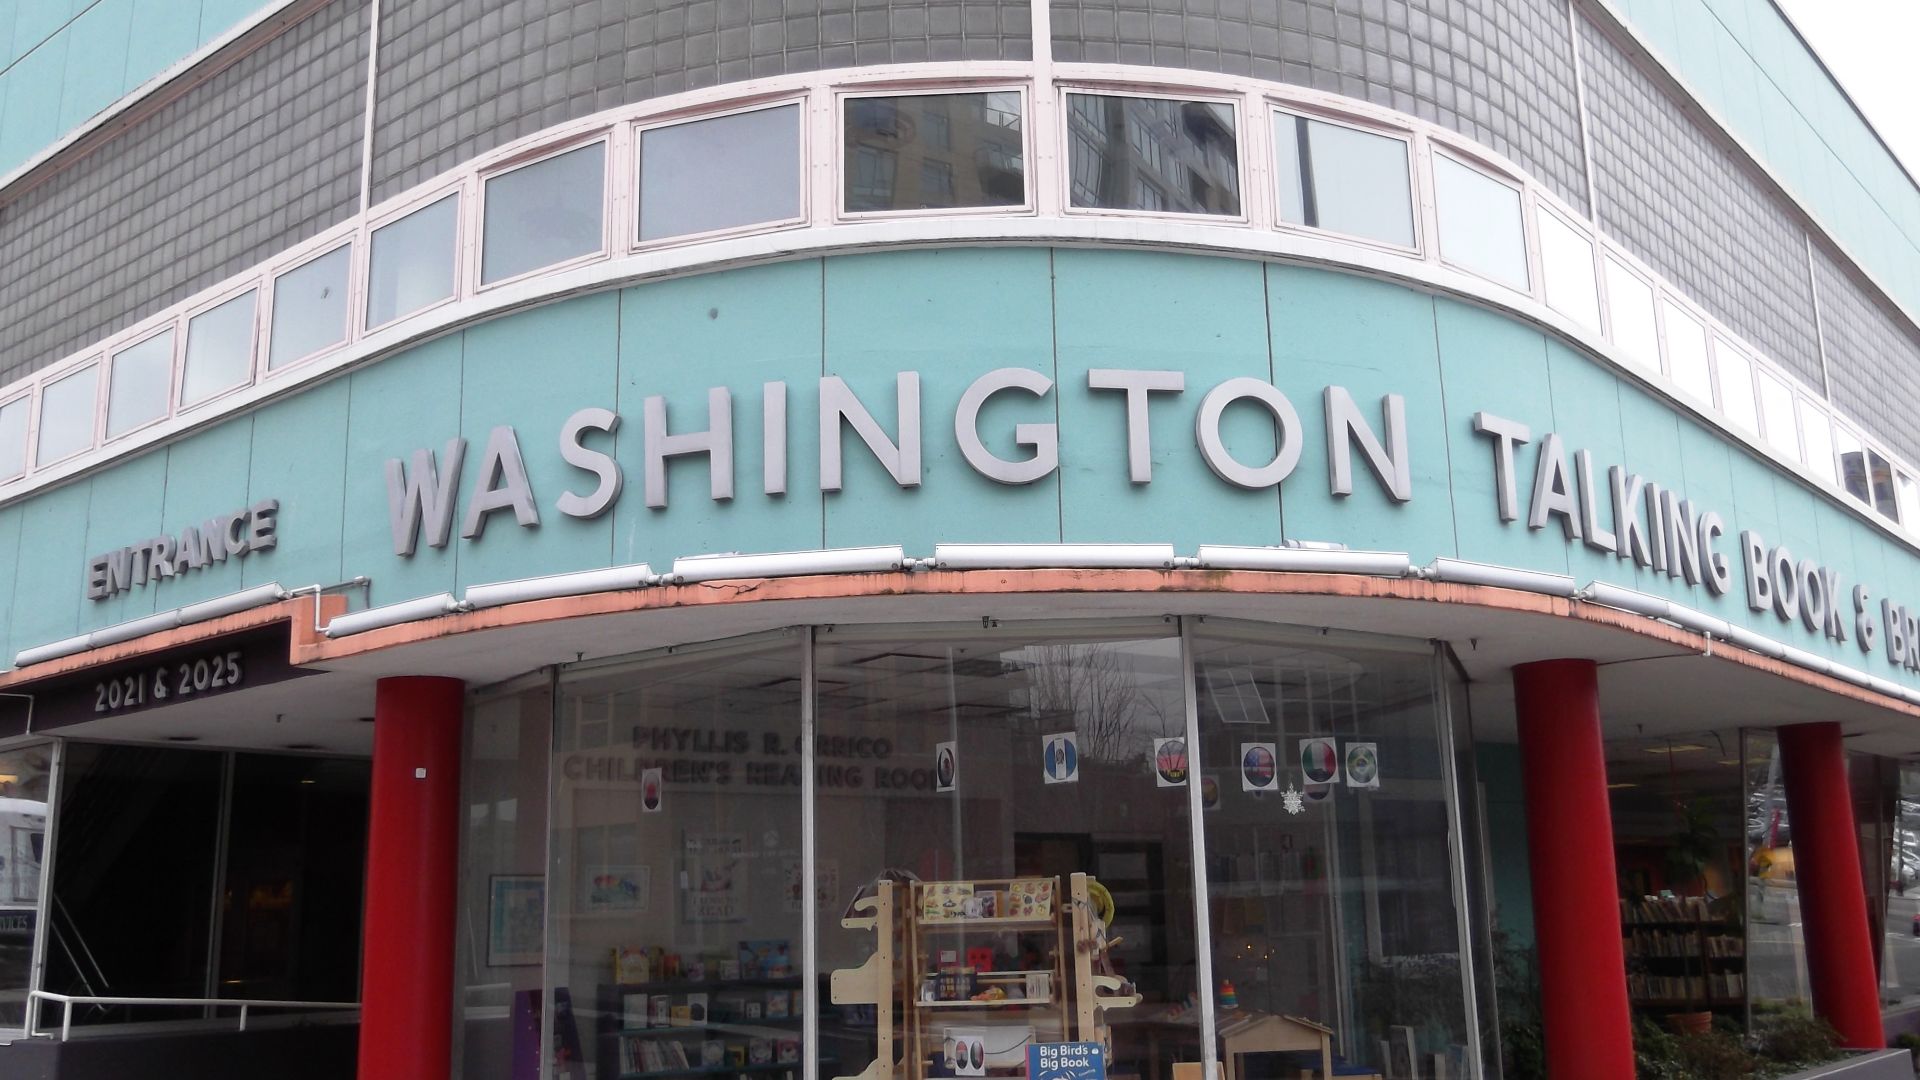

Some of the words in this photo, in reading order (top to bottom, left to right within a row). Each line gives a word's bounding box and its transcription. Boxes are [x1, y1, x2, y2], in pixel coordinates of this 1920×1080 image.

[384, 367, 1412, 557] WASHINGTON
[1473, 411, 1731, 596] TALKING
[1741, 530, 1848, 643] BOOK
[1853, 584, 1873, 654] &
[1881, 598, 1920, 675] BR
[88, 499, 279, 602] ENTRANCE
[94, 674, 145, 712] 2021
[154, 668, 170, 698] &
[179, 652, 243, 695] 2025
[632, 726, 749, 753] PHYLLIS
[763, 731, 788, 755] R.
[745, 759, 864, 788] REAING
[1040, 1046, 1058, 1059] Big
[1060, 1045, 1088, 1056] Bird's
[1040, 1057, 1059, 1071] Big
[1061, 1057, 1090, 1068] Book
